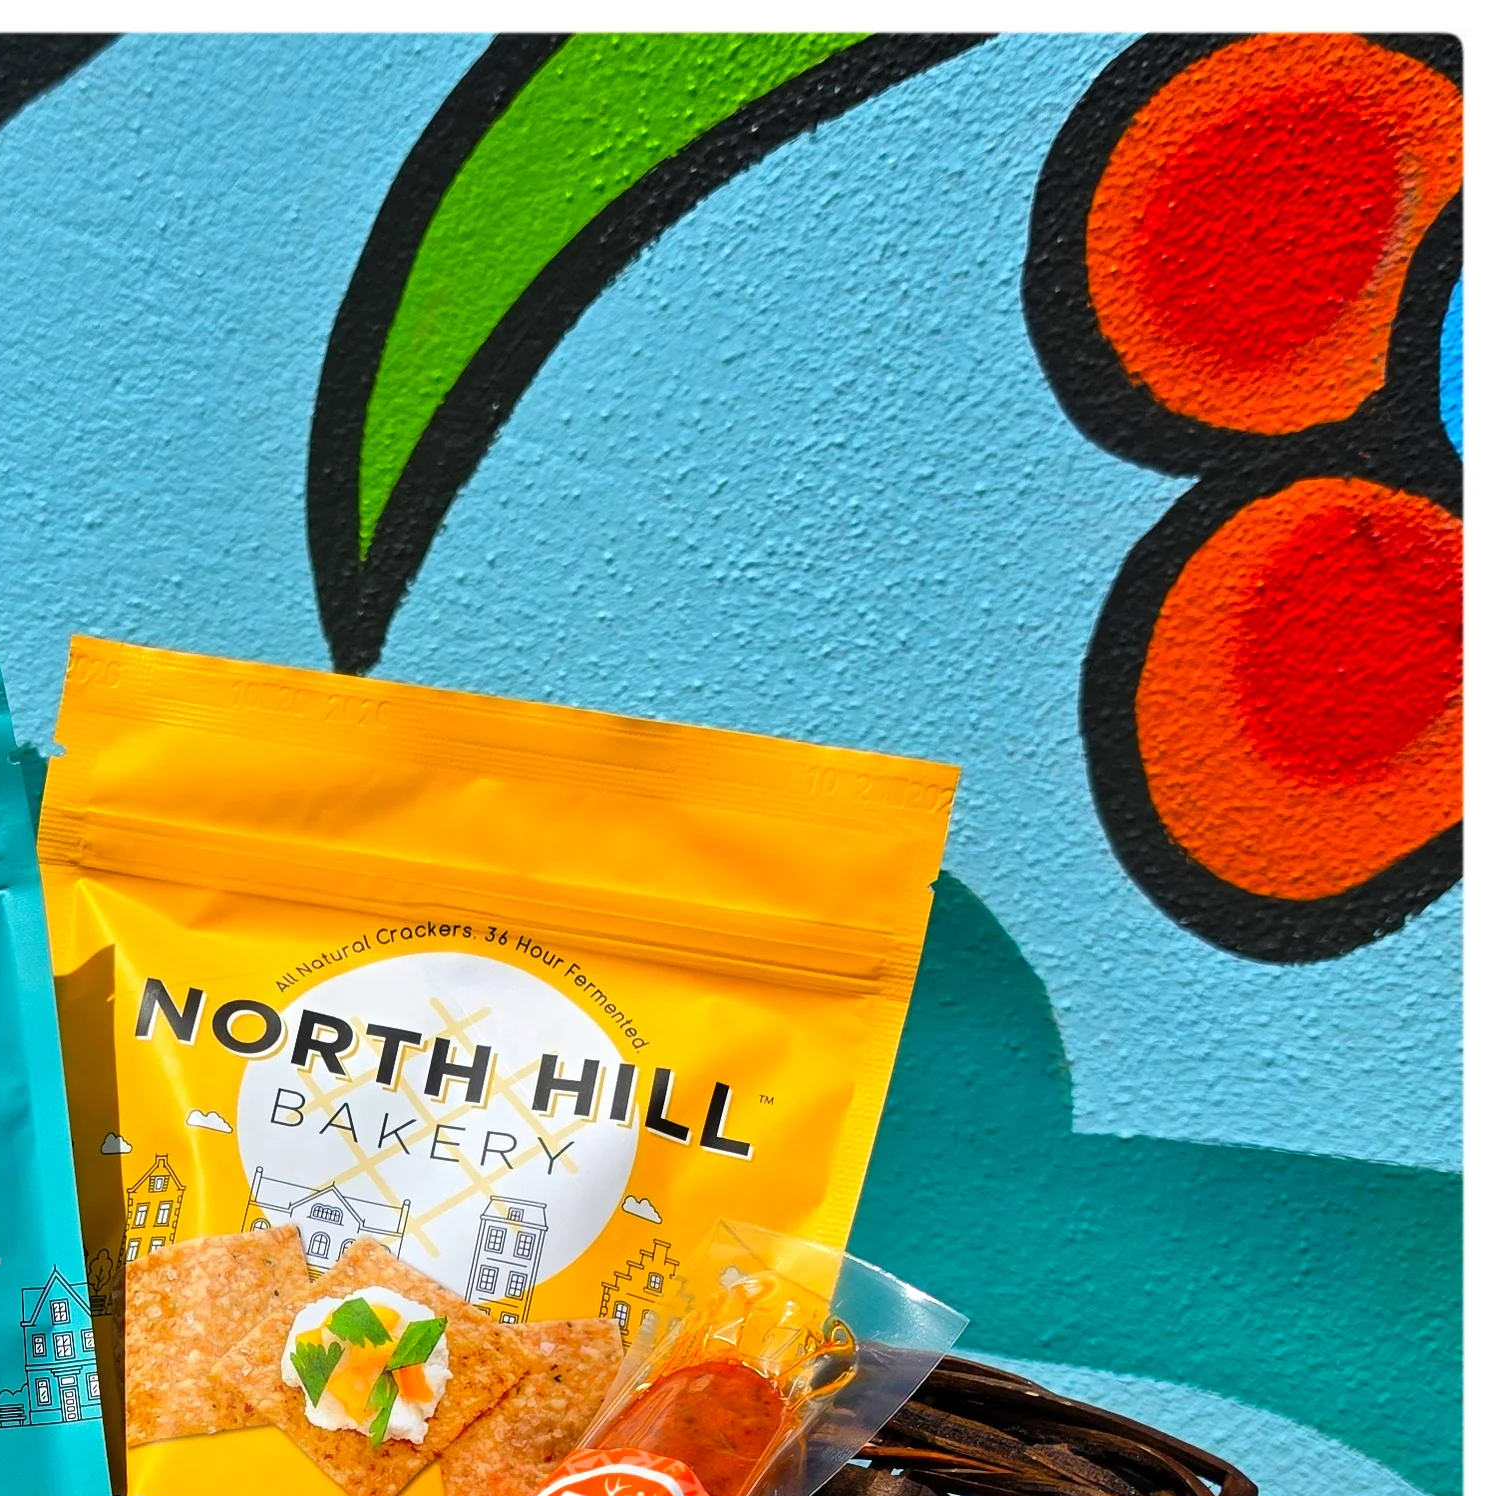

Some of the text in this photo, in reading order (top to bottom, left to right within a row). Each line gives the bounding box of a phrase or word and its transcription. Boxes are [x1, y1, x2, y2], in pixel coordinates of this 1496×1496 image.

[275, 920, 651, 1055] All Natural Crackers. 36 Hour Fermented.
[134, 976, 500, 1106] NORTH
[531, 1056, 755, 1161] HILL
[269, 1087, 577, 1176] BAKERY
